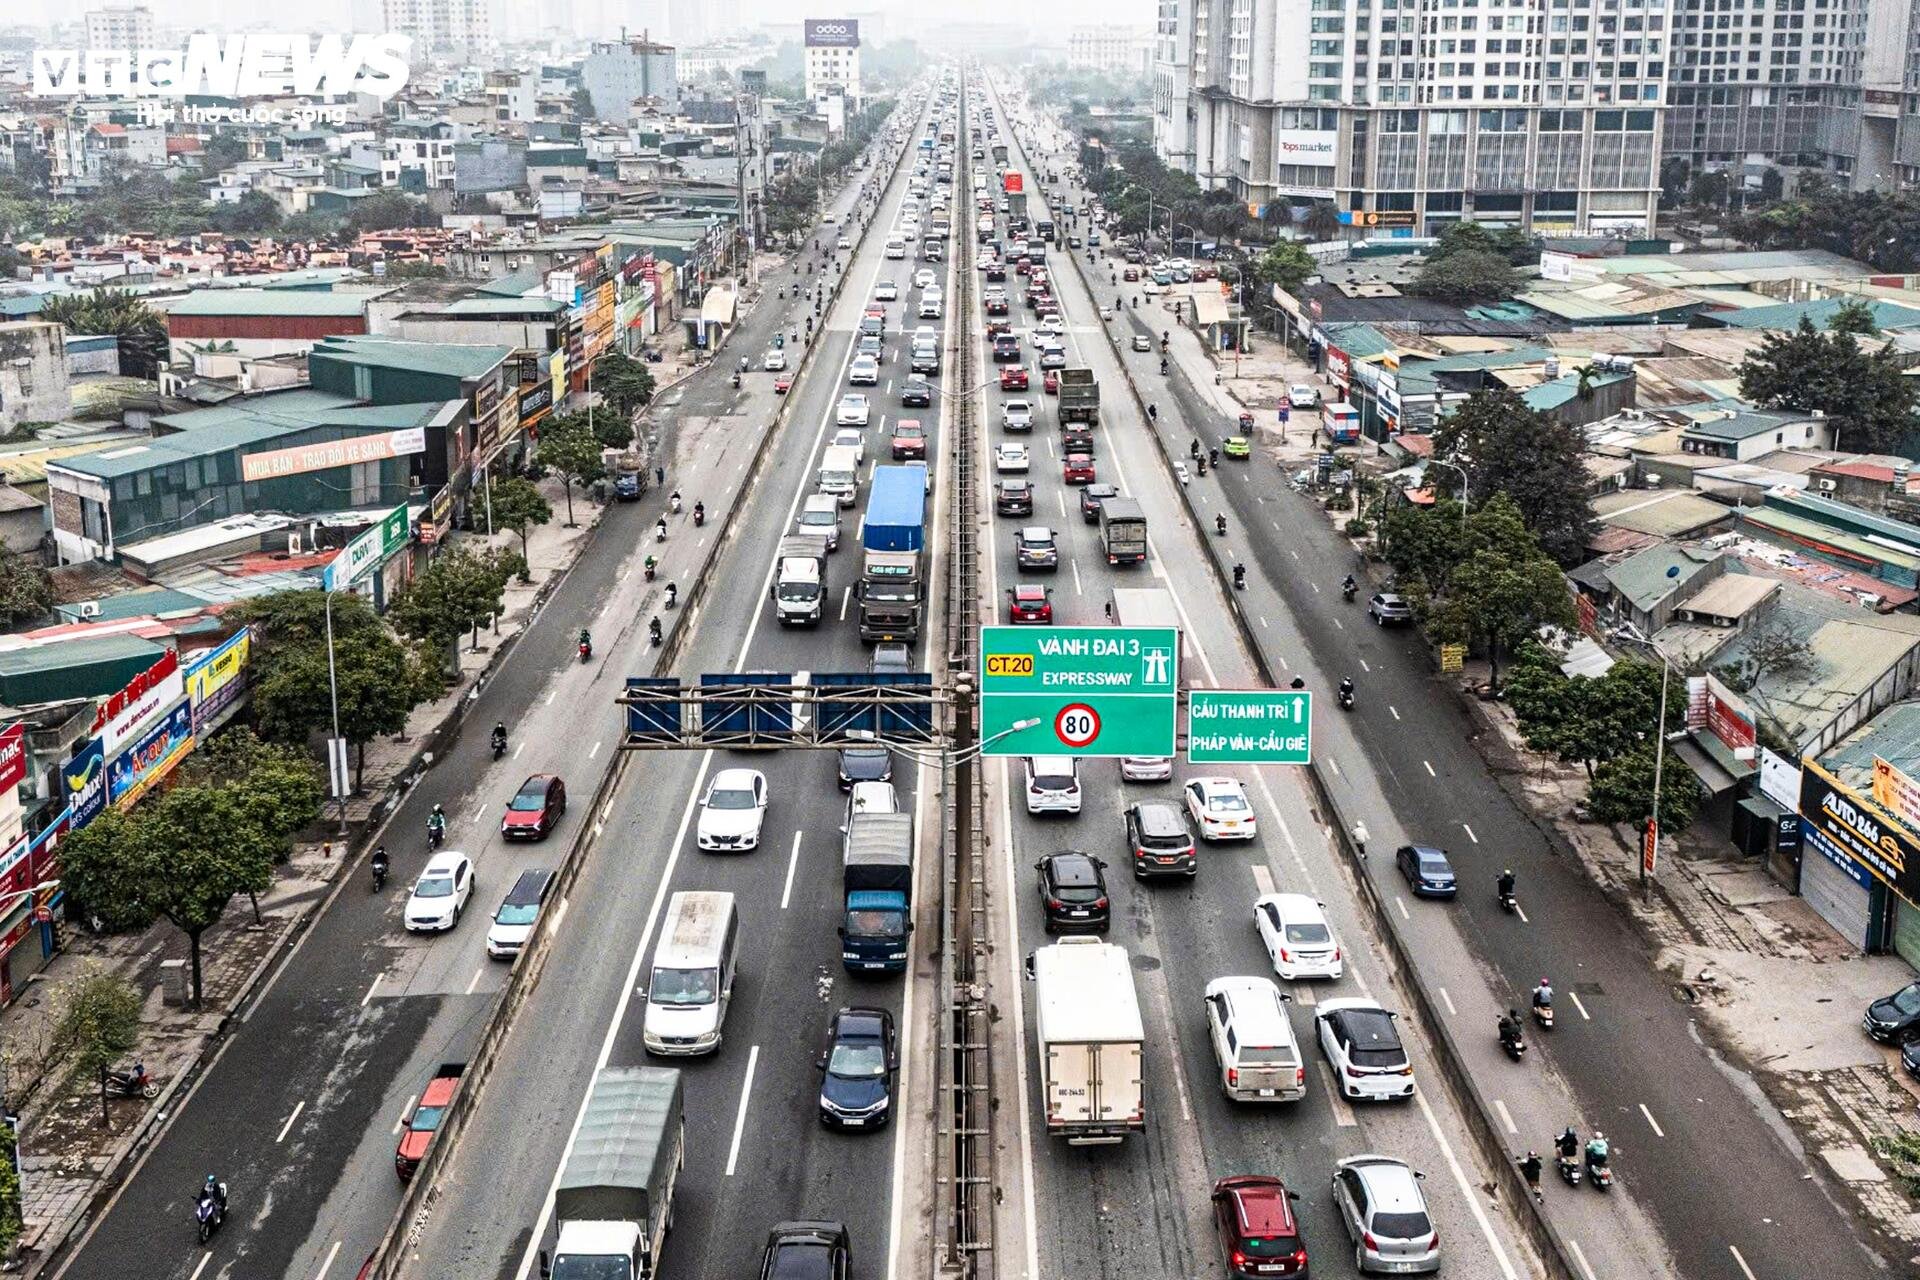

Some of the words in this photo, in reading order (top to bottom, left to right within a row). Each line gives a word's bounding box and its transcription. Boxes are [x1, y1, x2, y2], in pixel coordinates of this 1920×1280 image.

[816, 23, 847, 34] odoo
[1037, 635, 1089, 656] VÀNH
[1093, 639, 1125, 656] ĐAI
[1128, 639, 1140, 656] 3
[987, 657, 1033, 673] CT.20
[1042, 671, 1133, 686] EXPRESSWAY
[1220, 704, 1265, 719] THANH
[1065, 716, 1090, 735] 80
[1192, 732, 1228, 751] PHÁP
[69, 779, 102, 814] Dulux
[1822, 791, 1857, 827] AUTO
[1857, 815, 1879, 843] 266
